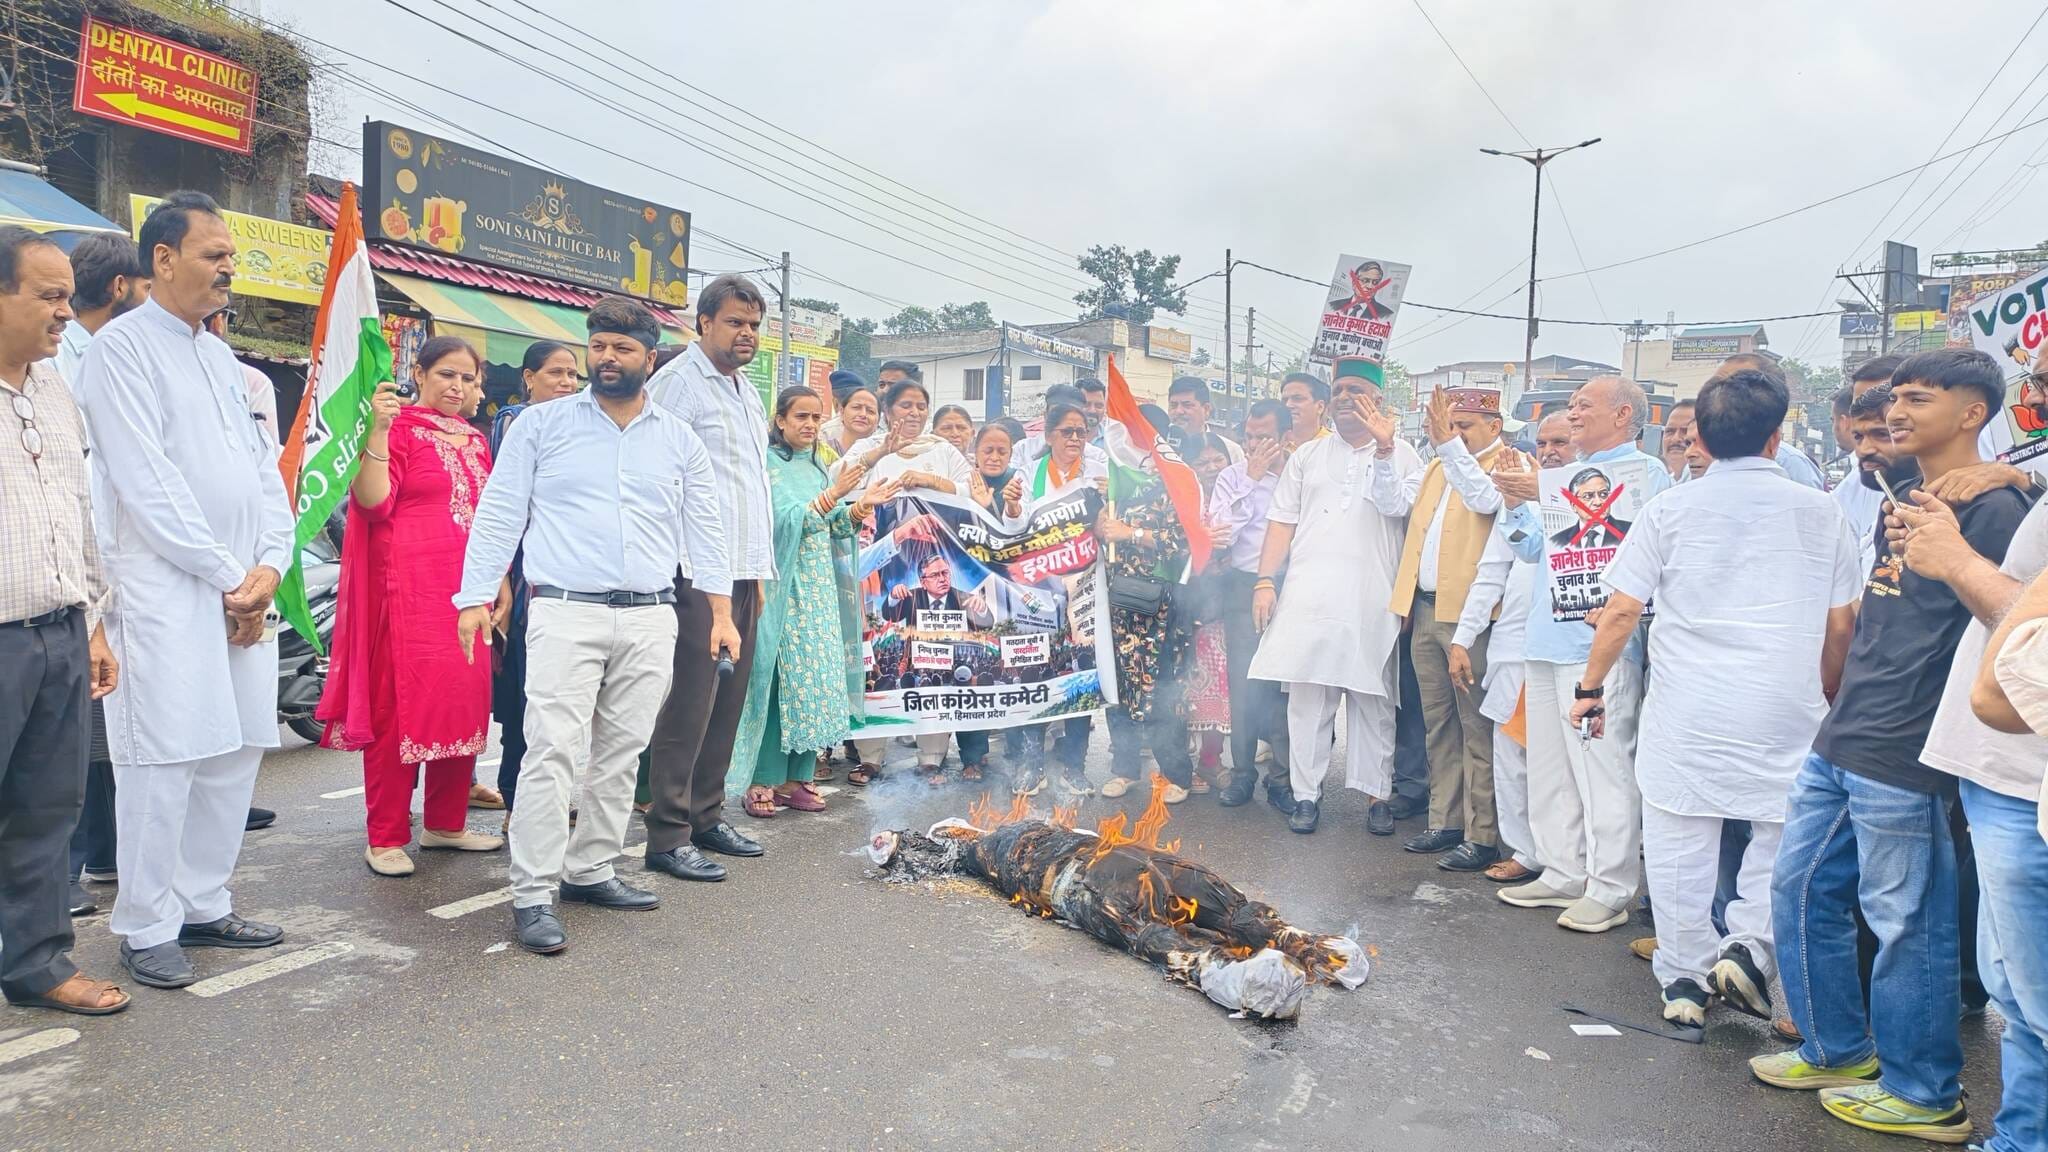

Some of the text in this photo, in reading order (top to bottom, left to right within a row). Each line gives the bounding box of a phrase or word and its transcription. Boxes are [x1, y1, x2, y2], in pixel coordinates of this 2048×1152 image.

[91, 23, 251, 93] DENTAL CLINIC
[91, 56, 247, 121] दाँतों का अस्पताल
[548, 198, 559, 215] S
[245, 220, 323, 253] SWEETS
[475, 214, 622, 264] SONI SAINI JUICE BAR
[1323, 312, 1392, 339] ज्ञानेश कुमार हटाओ
[1322, 330, 1384, 351] चुनाव आयोग बचाओ
[2010, 444, 2035, 462] DISTRICT
[1034, 499, 1088, 530] आयोग
[994, 544, 1024, 561] अब
[1064, 522, 1086, 538] के
[1019, 541, 1080, 583] इशारों
[1078, 536, 1097, 559] पर
[1550, 548, 1585, 571] ज्ञानेश
[1556, 573, 1585, 592] चुनाव
[942, 612, 963, 623] कुमार
[1565, 609, 1589, 619] DISTRICT
[1006, 637, 1026, 646] मतदाता
[902, 684, 1050, 712] जिला कांग्रेस कमेटी
[954, 709, 986, 721] हिमाचल
[987, 708, 1006, 719] प्रदेश
